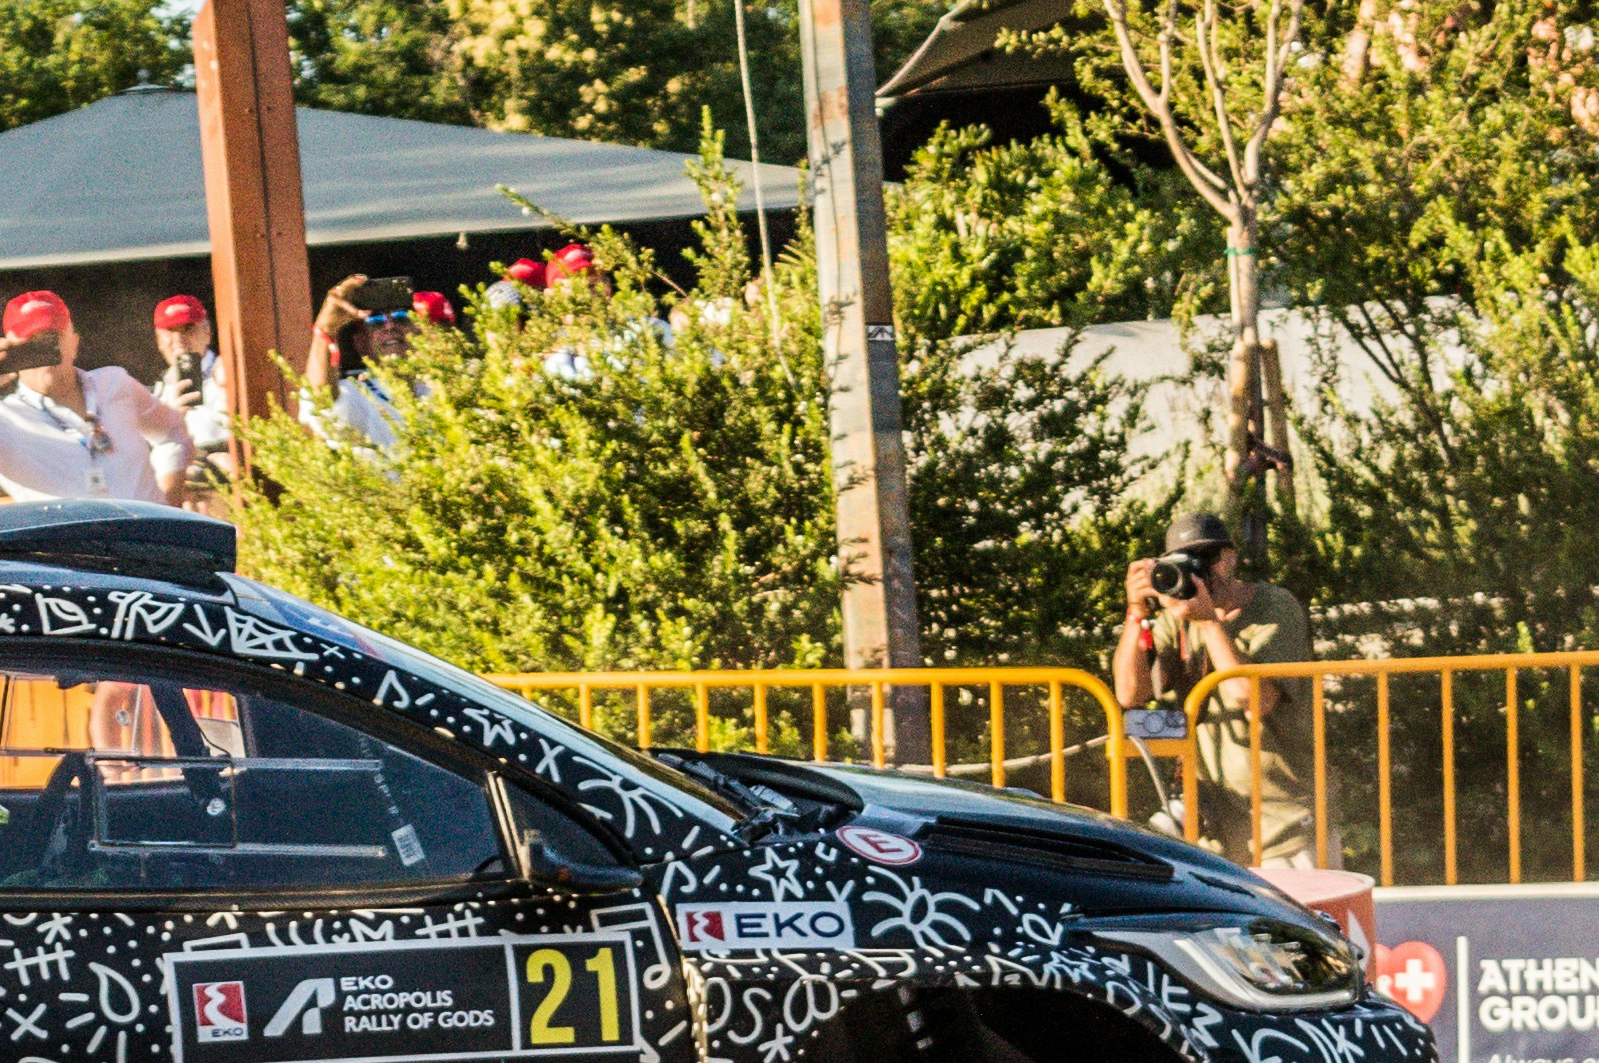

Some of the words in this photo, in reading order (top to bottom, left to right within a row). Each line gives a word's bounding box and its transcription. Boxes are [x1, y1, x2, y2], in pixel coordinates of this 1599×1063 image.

[859, 834, 902, 853] E
[735, 911, 845, 938] EKO
[340, 974, 393, 991] EKO
[343, 990, 453, 1011] ACROPOLIS
[526, 947, 620, 1044] 21
[344, 1012, 401, 1033] RALLY
[406, 1011, 434, 1029] OF
[438, 1008, 495, 1028] GODS
[1478, 994, 1599, 1032] GROU
[211, 1027, 243, 1038] EKO
